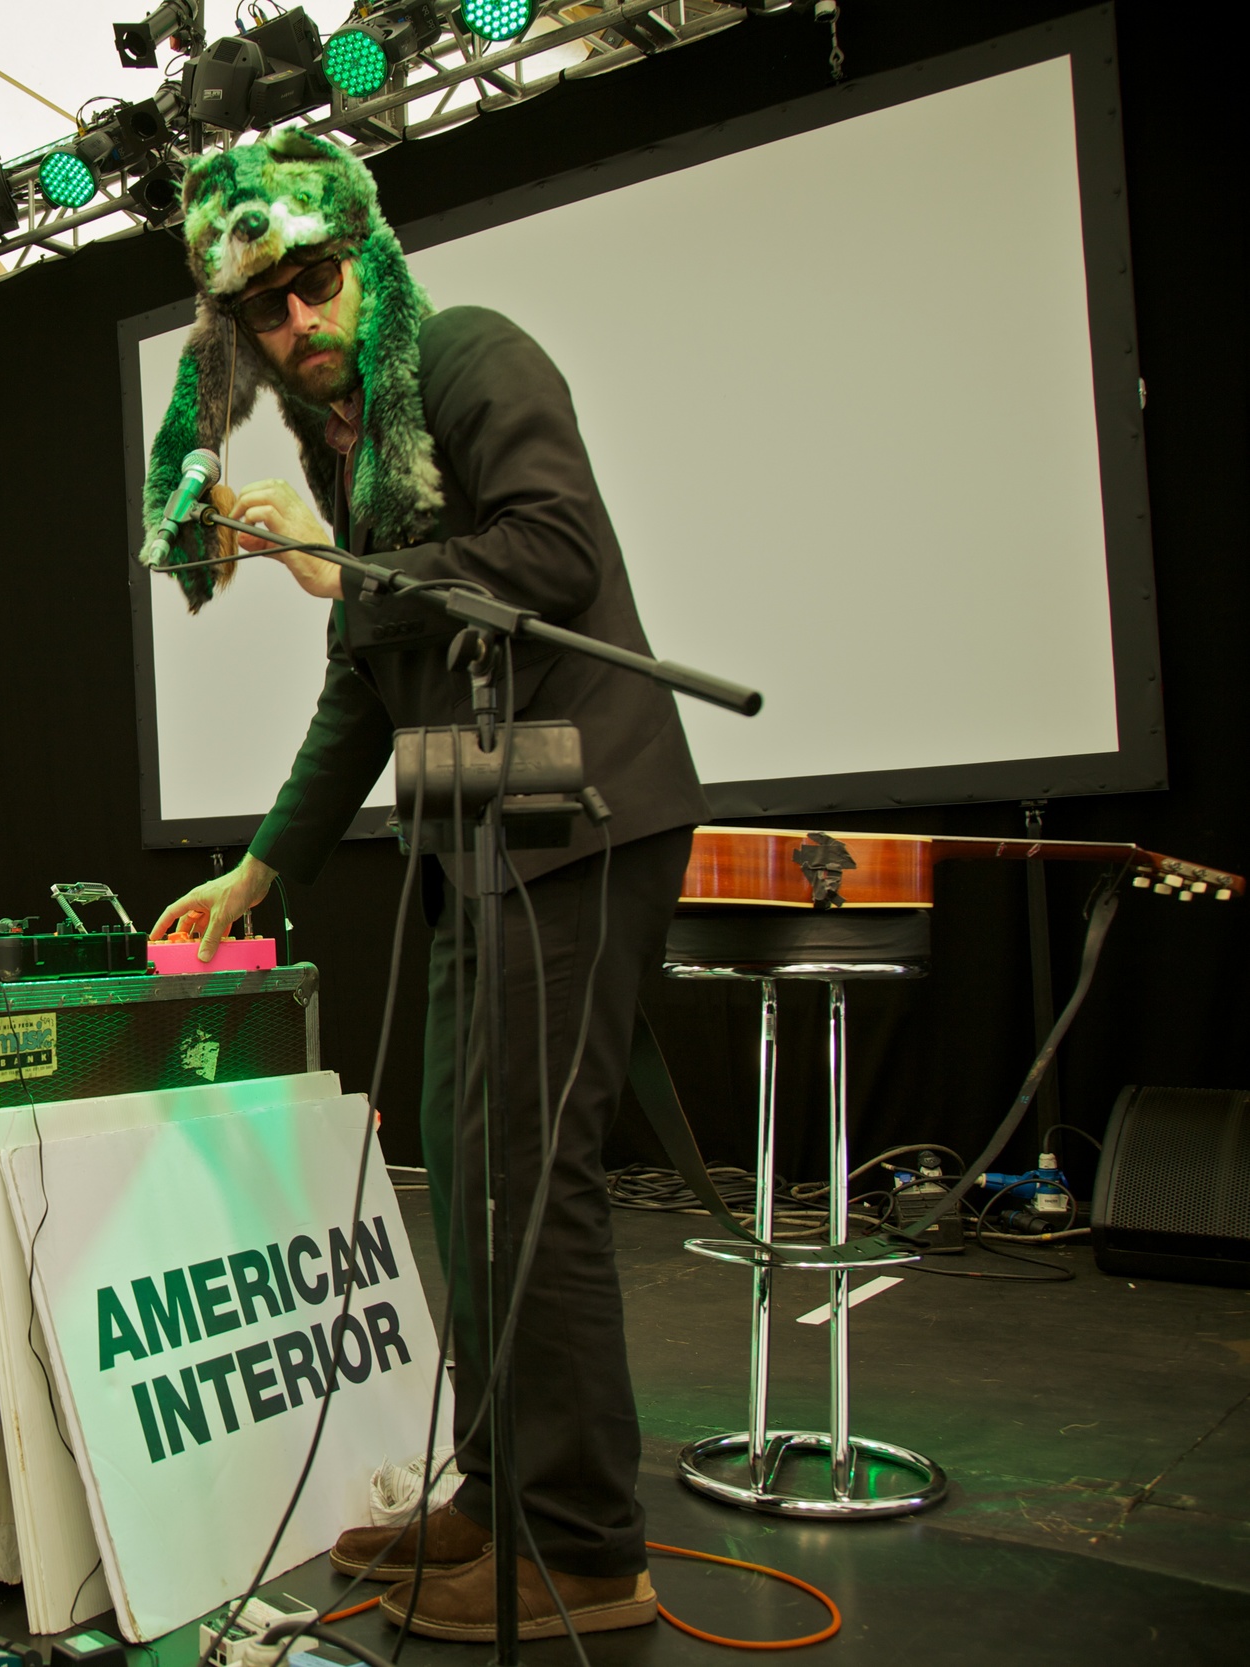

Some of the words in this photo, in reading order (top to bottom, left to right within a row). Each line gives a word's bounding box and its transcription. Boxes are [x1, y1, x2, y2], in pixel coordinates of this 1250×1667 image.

[0, 1053, 47, 1067] BANK
[97, 1216, 400, 1371] AMERICAN
[131, 1301, 412, 1463] INTERIOR
